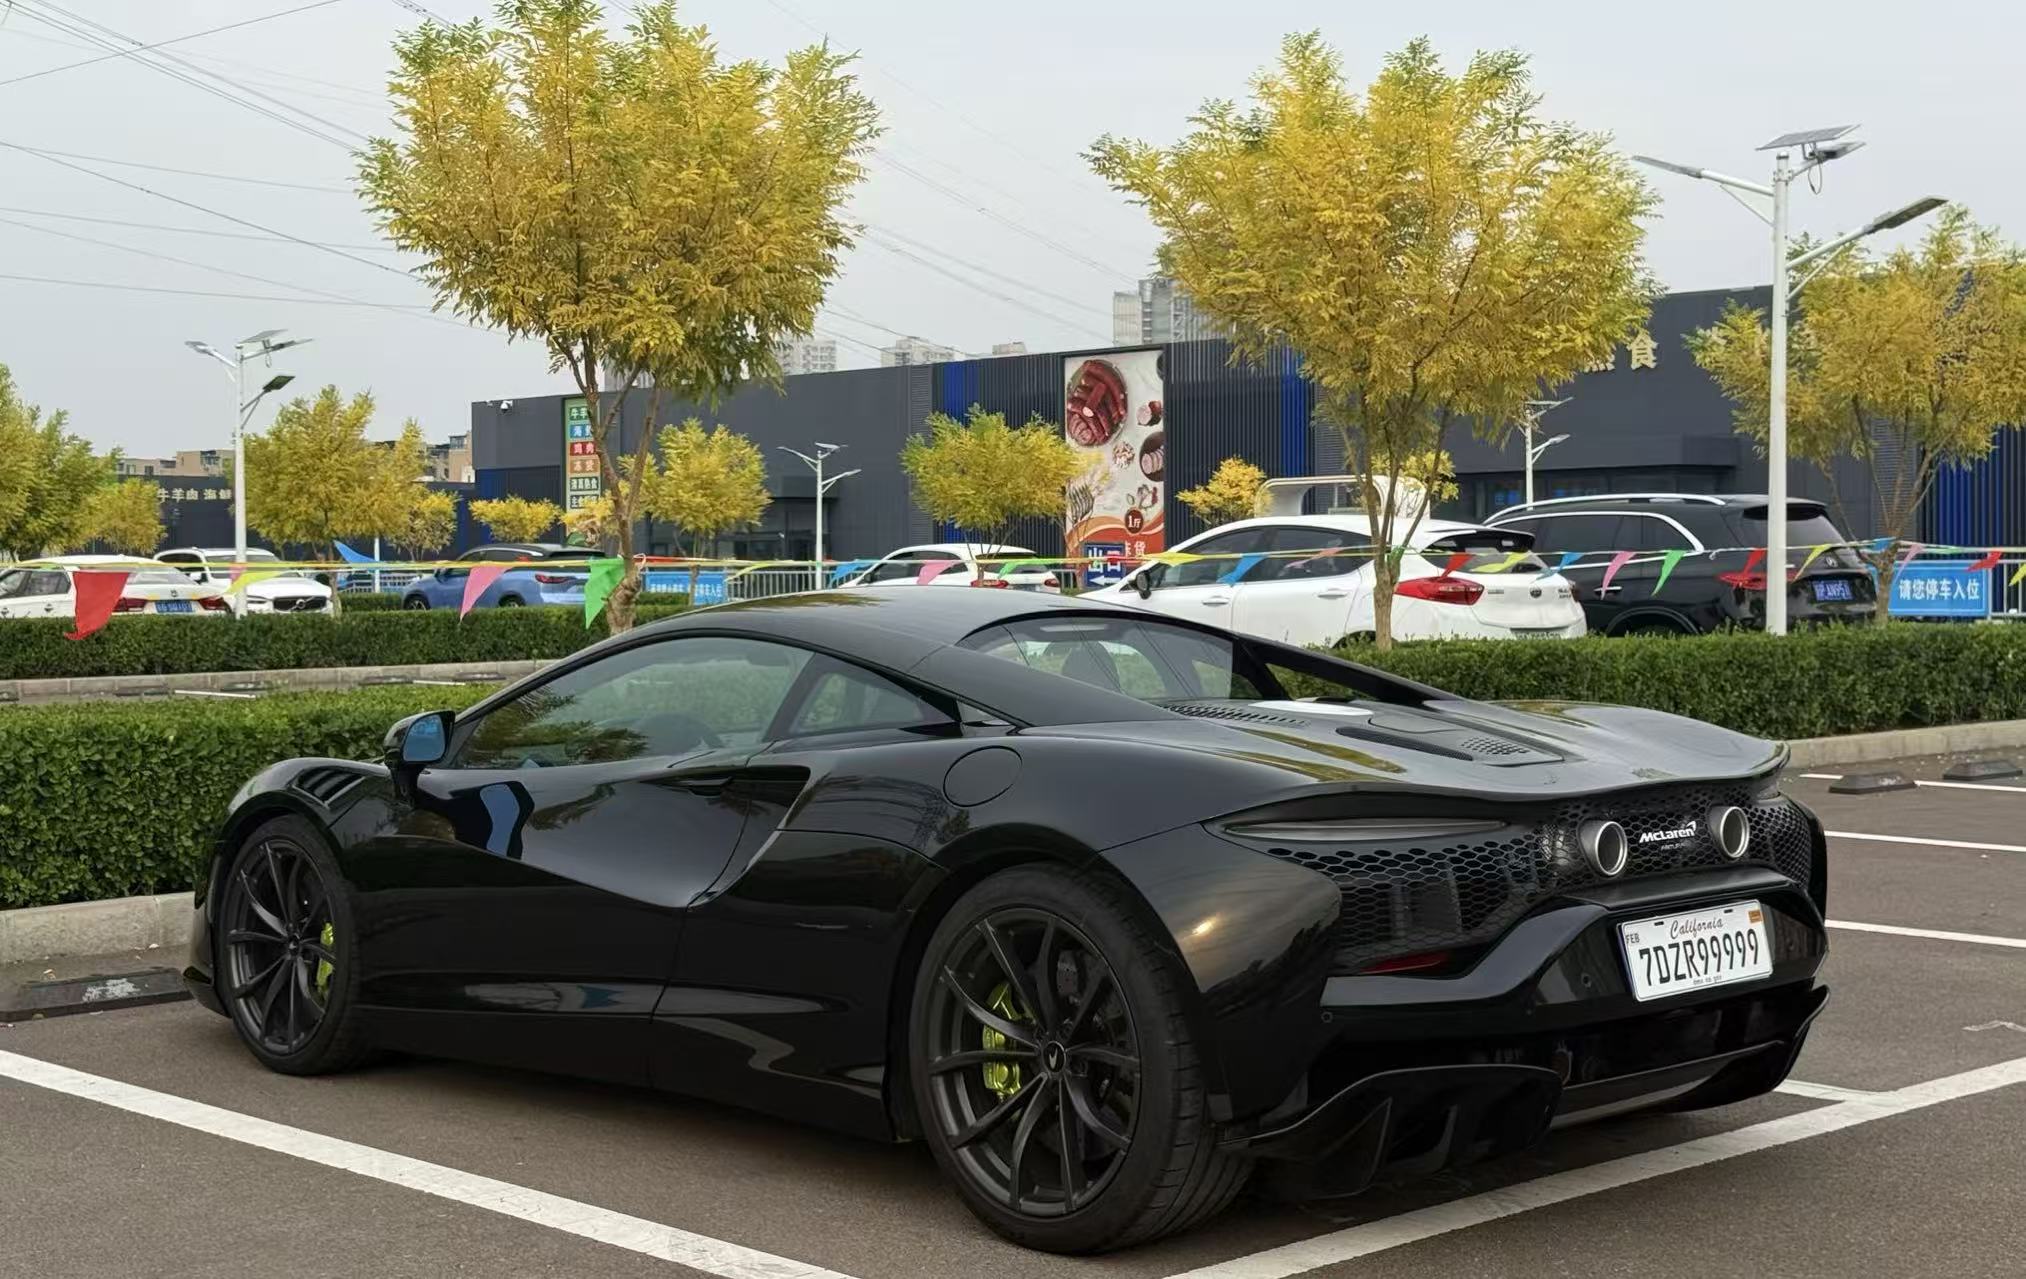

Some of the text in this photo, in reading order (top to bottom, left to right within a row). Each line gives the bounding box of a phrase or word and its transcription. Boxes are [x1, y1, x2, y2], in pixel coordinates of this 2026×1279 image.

[570, 407, 588, 420] 牛羊
[157, 488, 198, 503] 牛羊肉
[1088, 547, 1121, 573] 出口
[1900, 579, 1980, 600] 请您停车入位
[1639, 827, 1696, 844] McLaren
[1670, 917, 1724, 939] California
[1625, 933, 1640, 944] FEB
[1639, 928, 1759, 987] 7DZR99999
